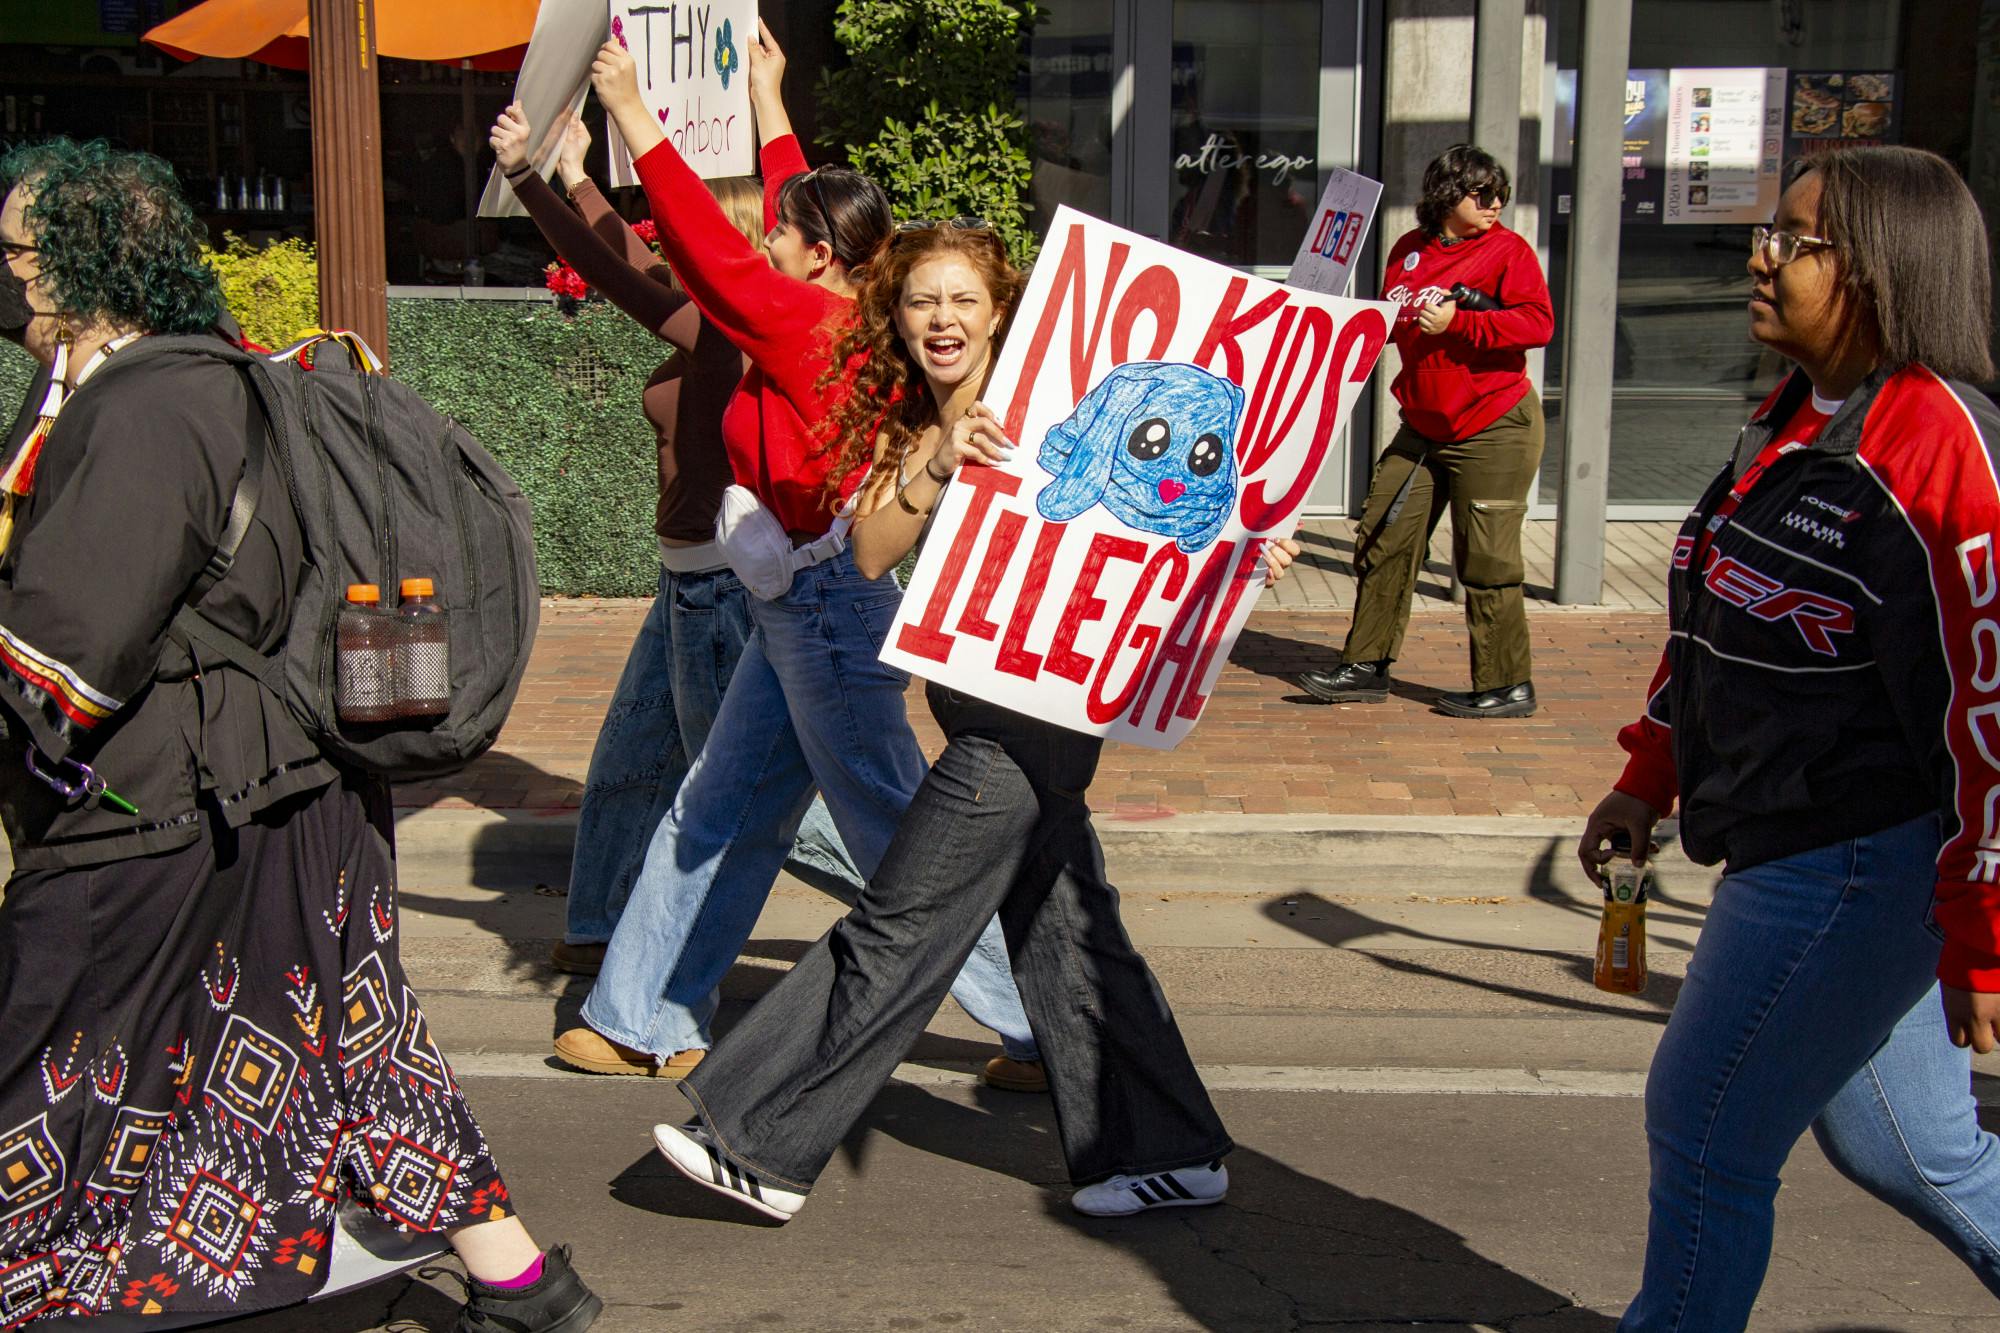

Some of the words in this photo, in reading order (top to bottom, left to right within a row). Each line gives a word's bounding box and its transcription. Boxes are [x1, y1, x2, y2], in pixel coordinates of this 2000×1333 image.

[628, 1, 710, 91] THY
[1311, 209, 1364, 266] ICE
[1386, 285, 1413, 307] Six
[1002, 224, 1181, 446] NO
[1190, 276, 1388, 532] KIDS
[896, 464, 1270, 733] ILLEGAL
